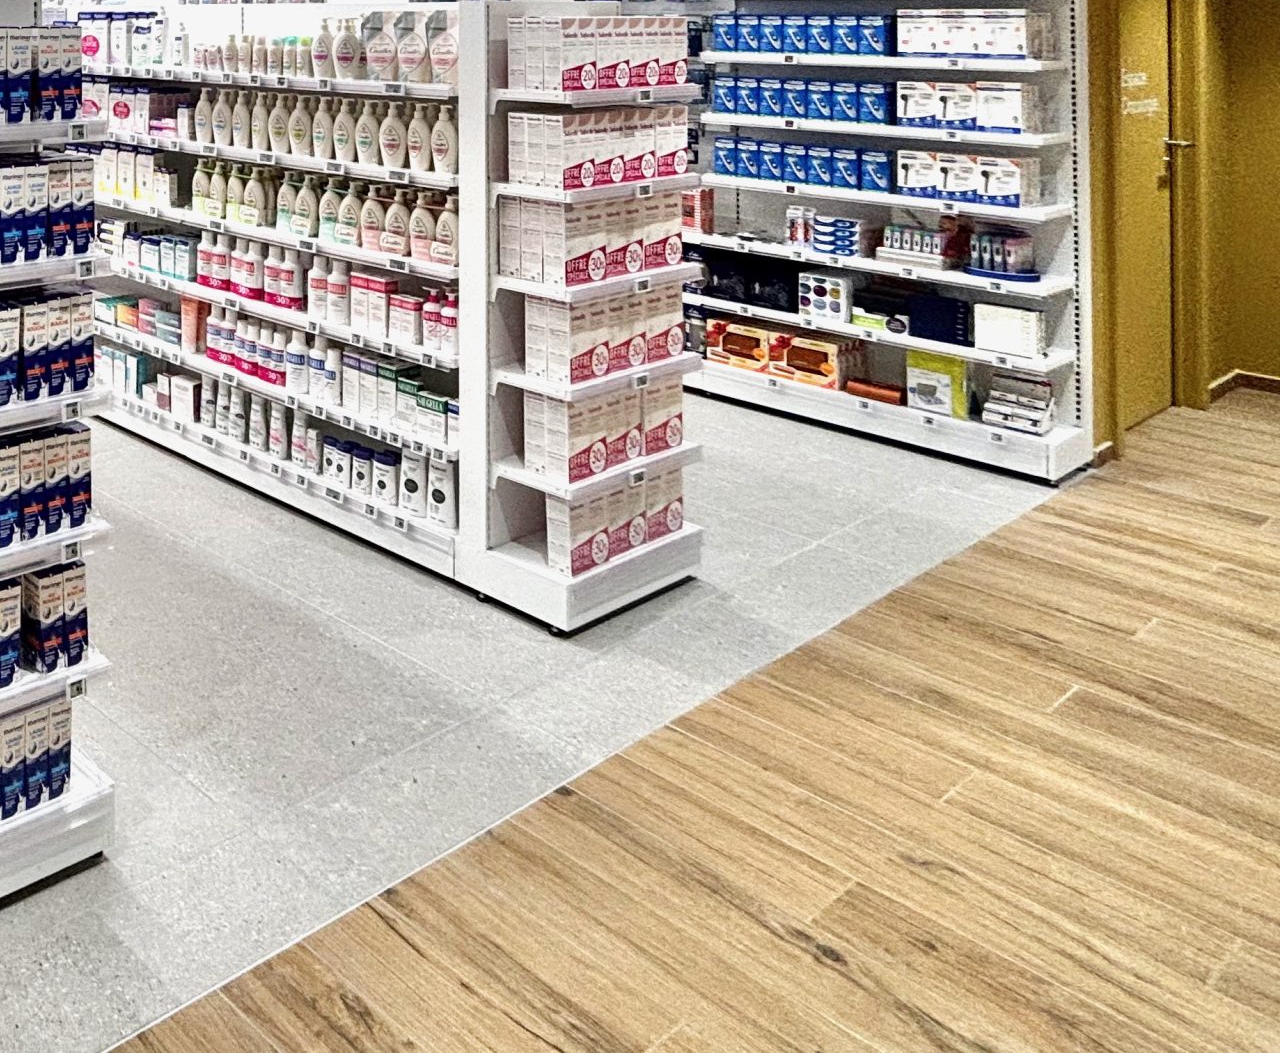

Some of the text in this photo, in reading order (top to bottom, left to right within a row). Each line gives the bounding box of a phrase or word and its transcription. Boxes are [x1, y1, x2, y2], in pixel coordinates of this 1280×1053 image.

[563, 70, 580, 80] OFFRE
[599, 68, 615, 78] OFFRE
[607, 252, 625, 265] OFFRE
[567, 260, 587, 273] OFFRE
